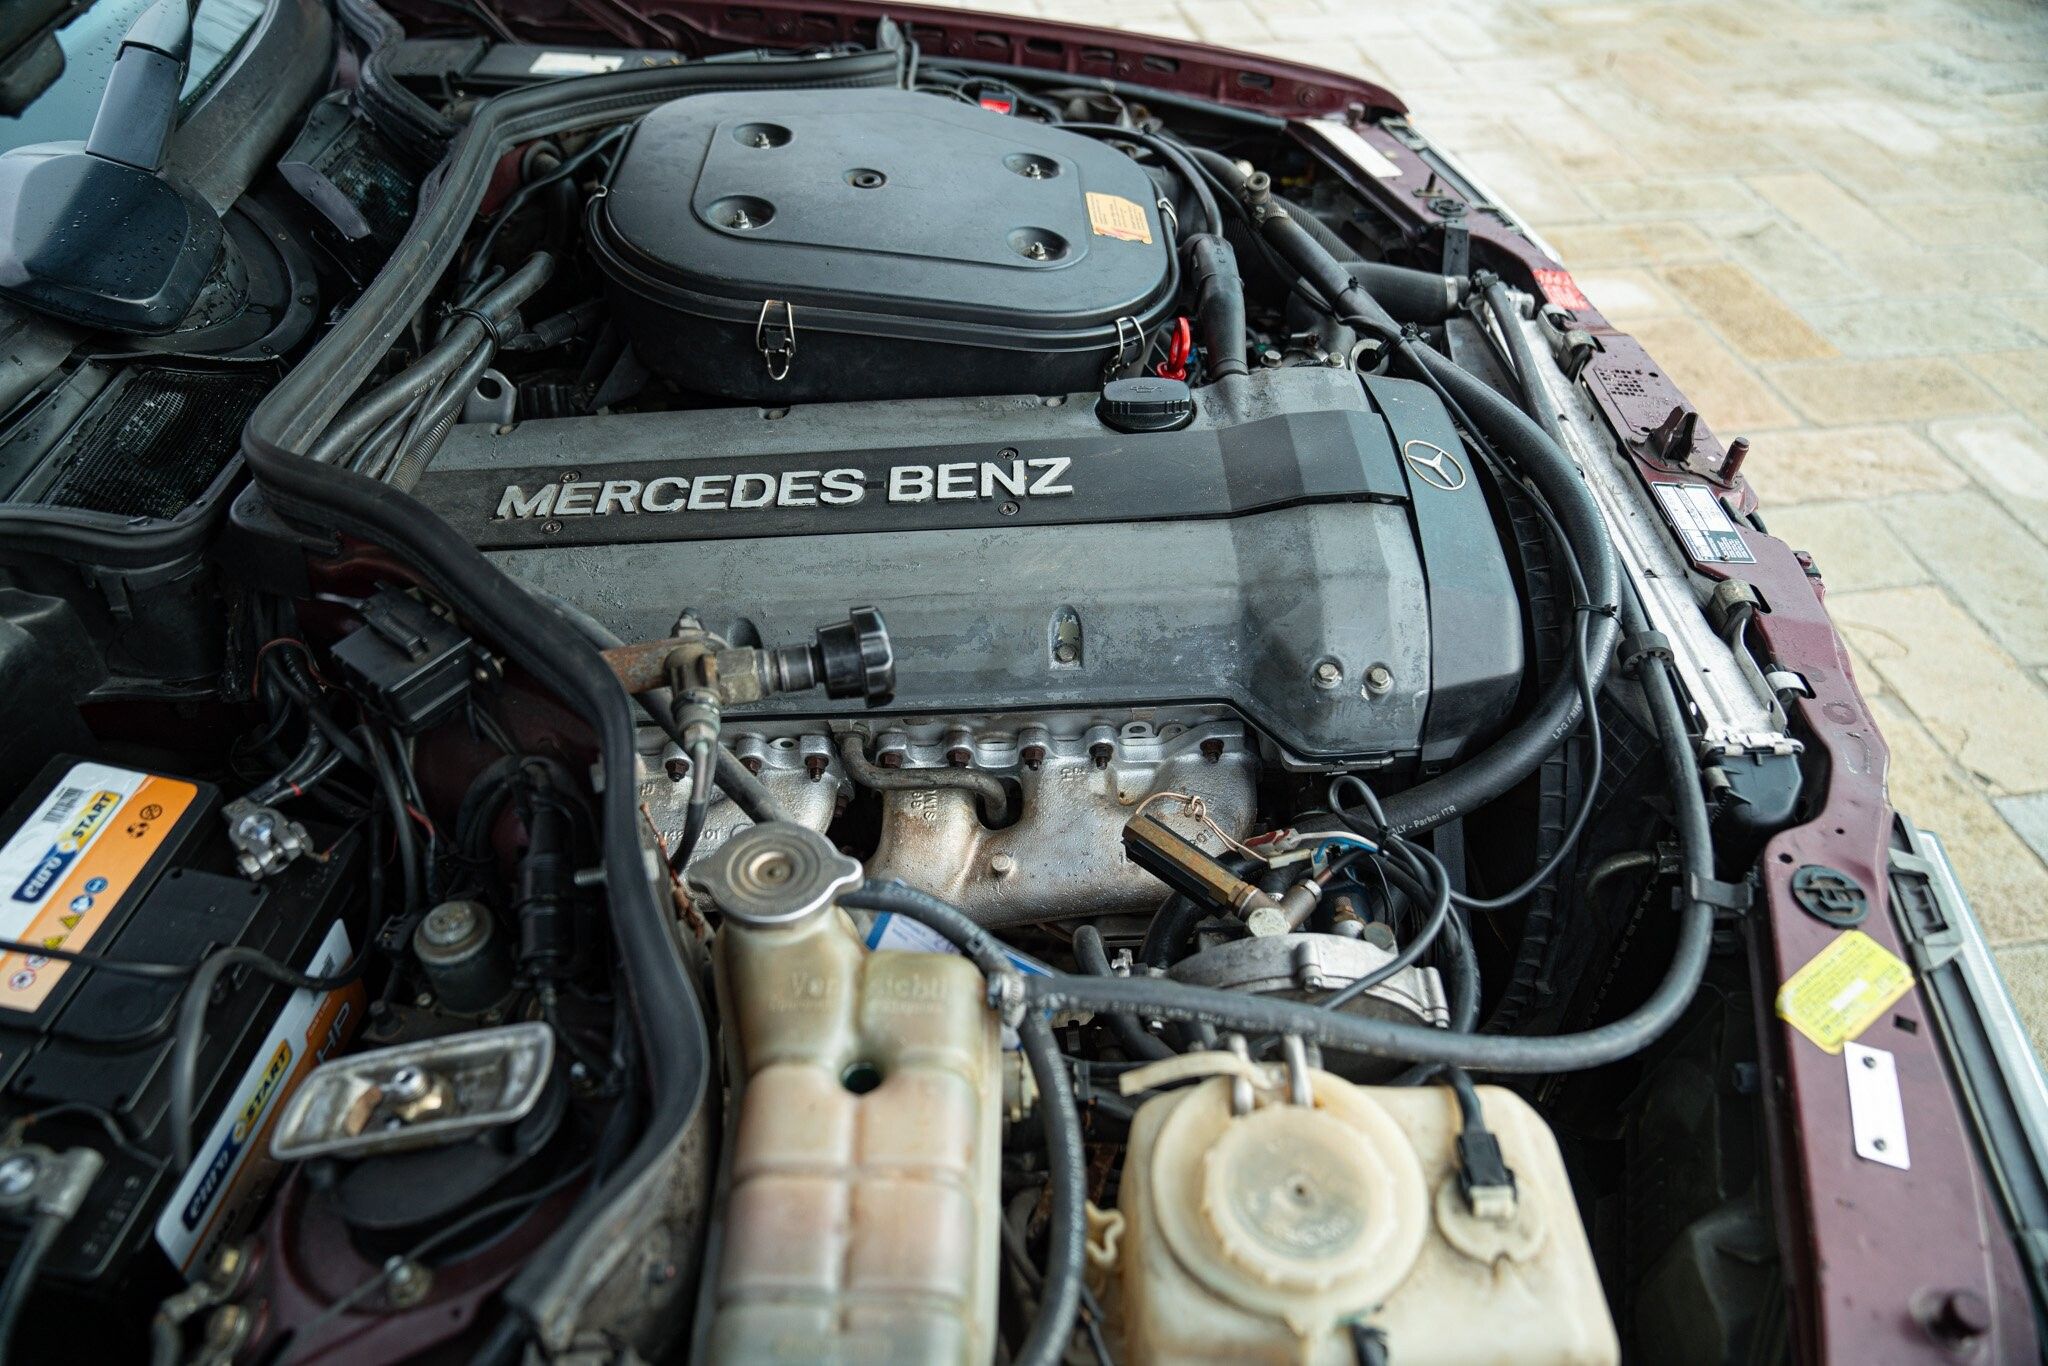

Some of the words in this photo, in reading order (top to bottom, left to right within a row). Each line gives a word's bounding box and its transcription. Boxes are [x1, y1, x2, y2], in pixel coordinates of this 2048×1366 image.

[493, 467, 867, 519] MERCEDES
[887, 456, 1075, 502] BENZ
[71, 793, 112, 838] START
[246, 1050, 288, 1121] START
